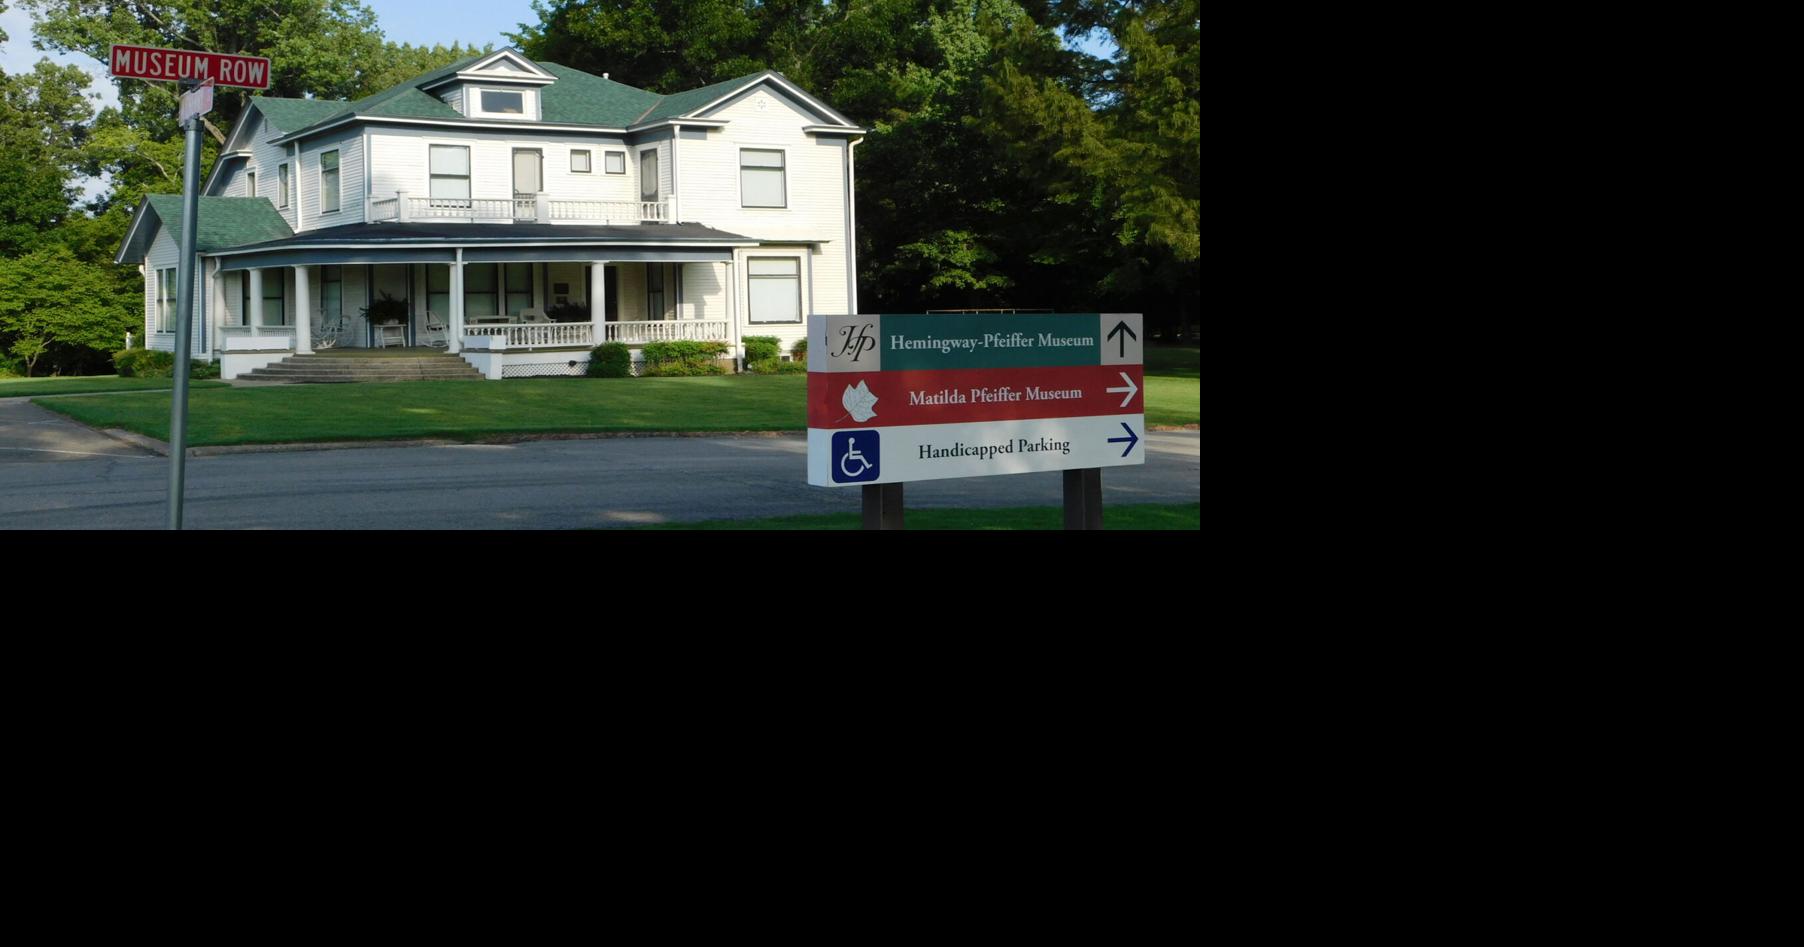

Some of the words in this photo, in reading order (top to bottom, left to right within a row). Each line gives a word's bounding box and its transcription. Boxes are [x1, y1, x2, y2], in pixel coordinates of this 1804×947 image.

[115, 49, 209, 79] MUSEUM
[219, 58, 265, 85] ROW
[890, 333, 1034, 353] Hemingway-Pfeiffer
[1038, 332, 1094, 347] Museum
[909, 389, 966, 406] Matilda
[971, 387, 1022, 403] Pfeiffer
[1025, 386, 1082, 401] Museum
[918, 439, 1013, 460] Handicapped
[1018, 437, 1070, 454] Parking
